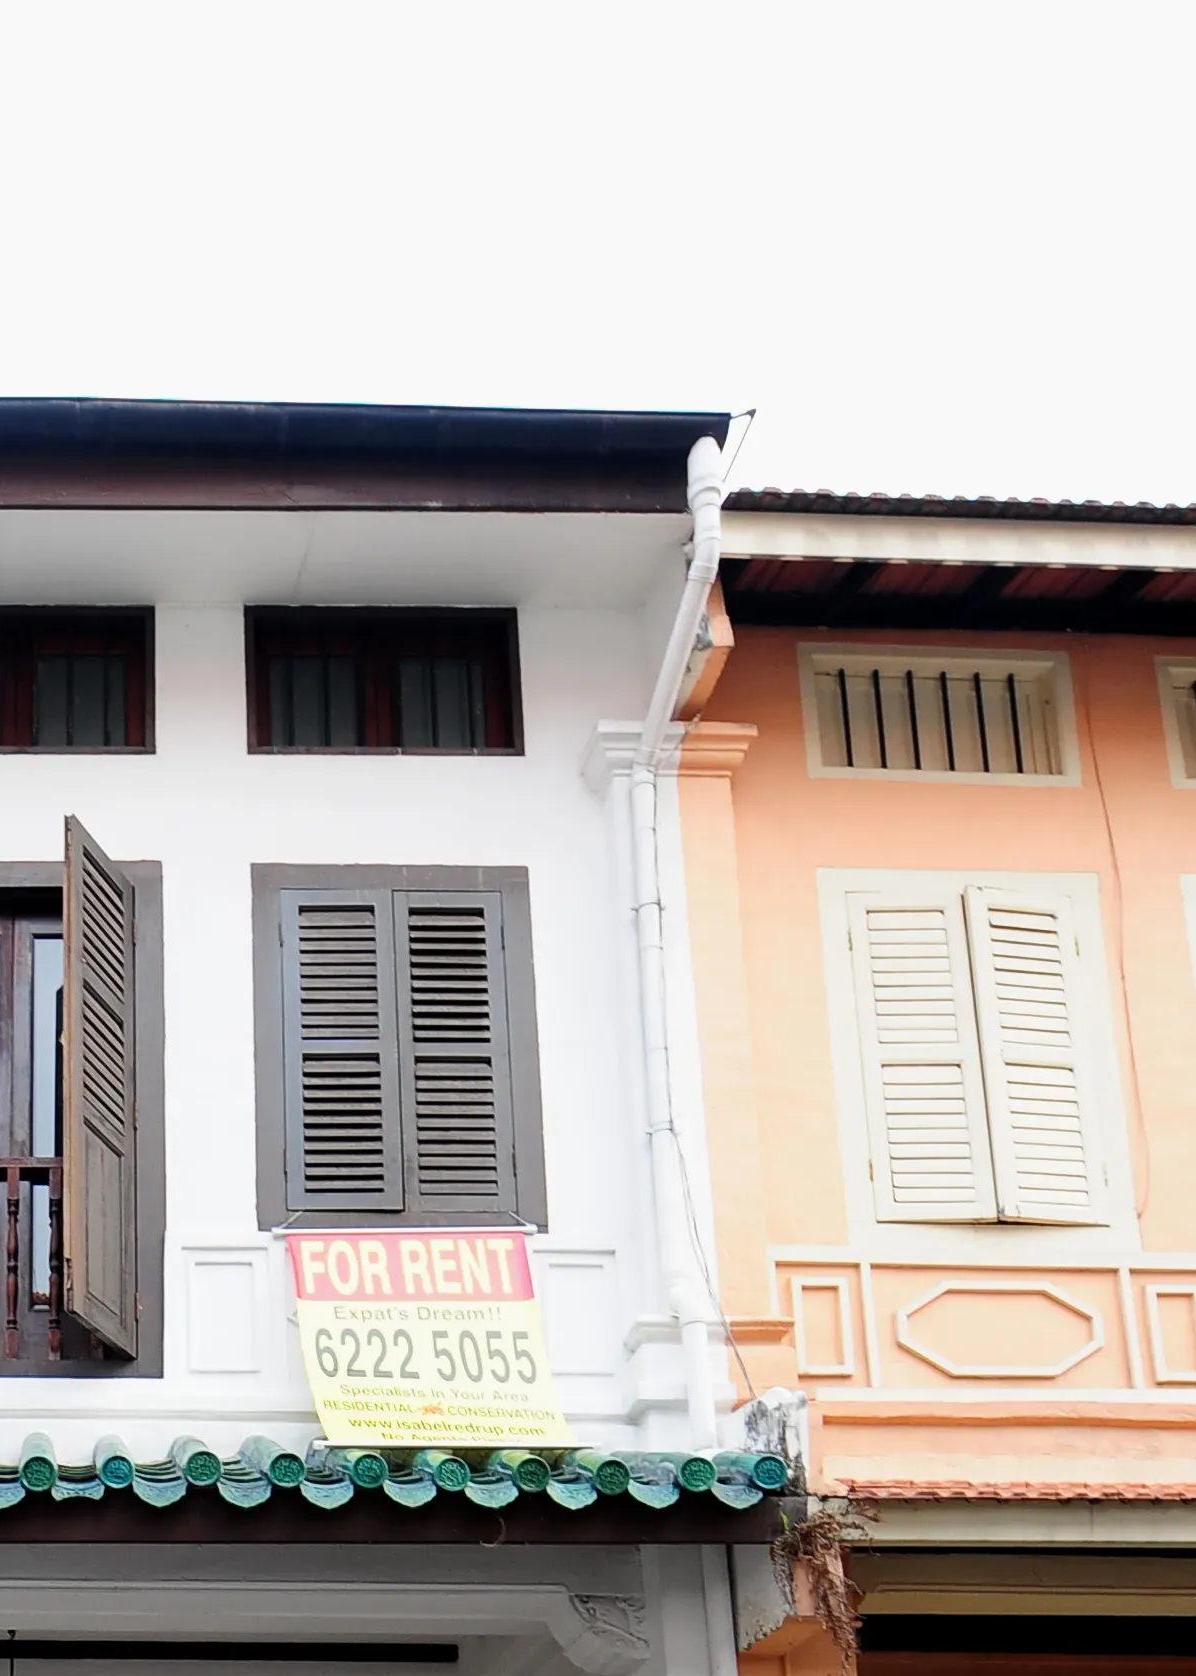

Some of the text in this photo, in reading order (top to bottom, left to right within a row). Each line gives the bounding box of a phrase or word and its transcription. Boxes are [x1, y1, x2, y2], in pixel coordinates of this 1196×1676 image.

[300, 1238, 514, 1295] FOR RENT
[333, 1305, 502, 1323] Expat's Dream!!
[315, 1328, 537, 1384] 6222 5055
[340, 1384, 426, 1398] Specialists
[450, 1388, 485, 1401] Your
[493, 1389, 529, 1402] Area
[323, 1400, 555, 1420] RESIDENTIAL CONSERVATION
[348, 1418, 546, 1436] www.isabelredrup.com
